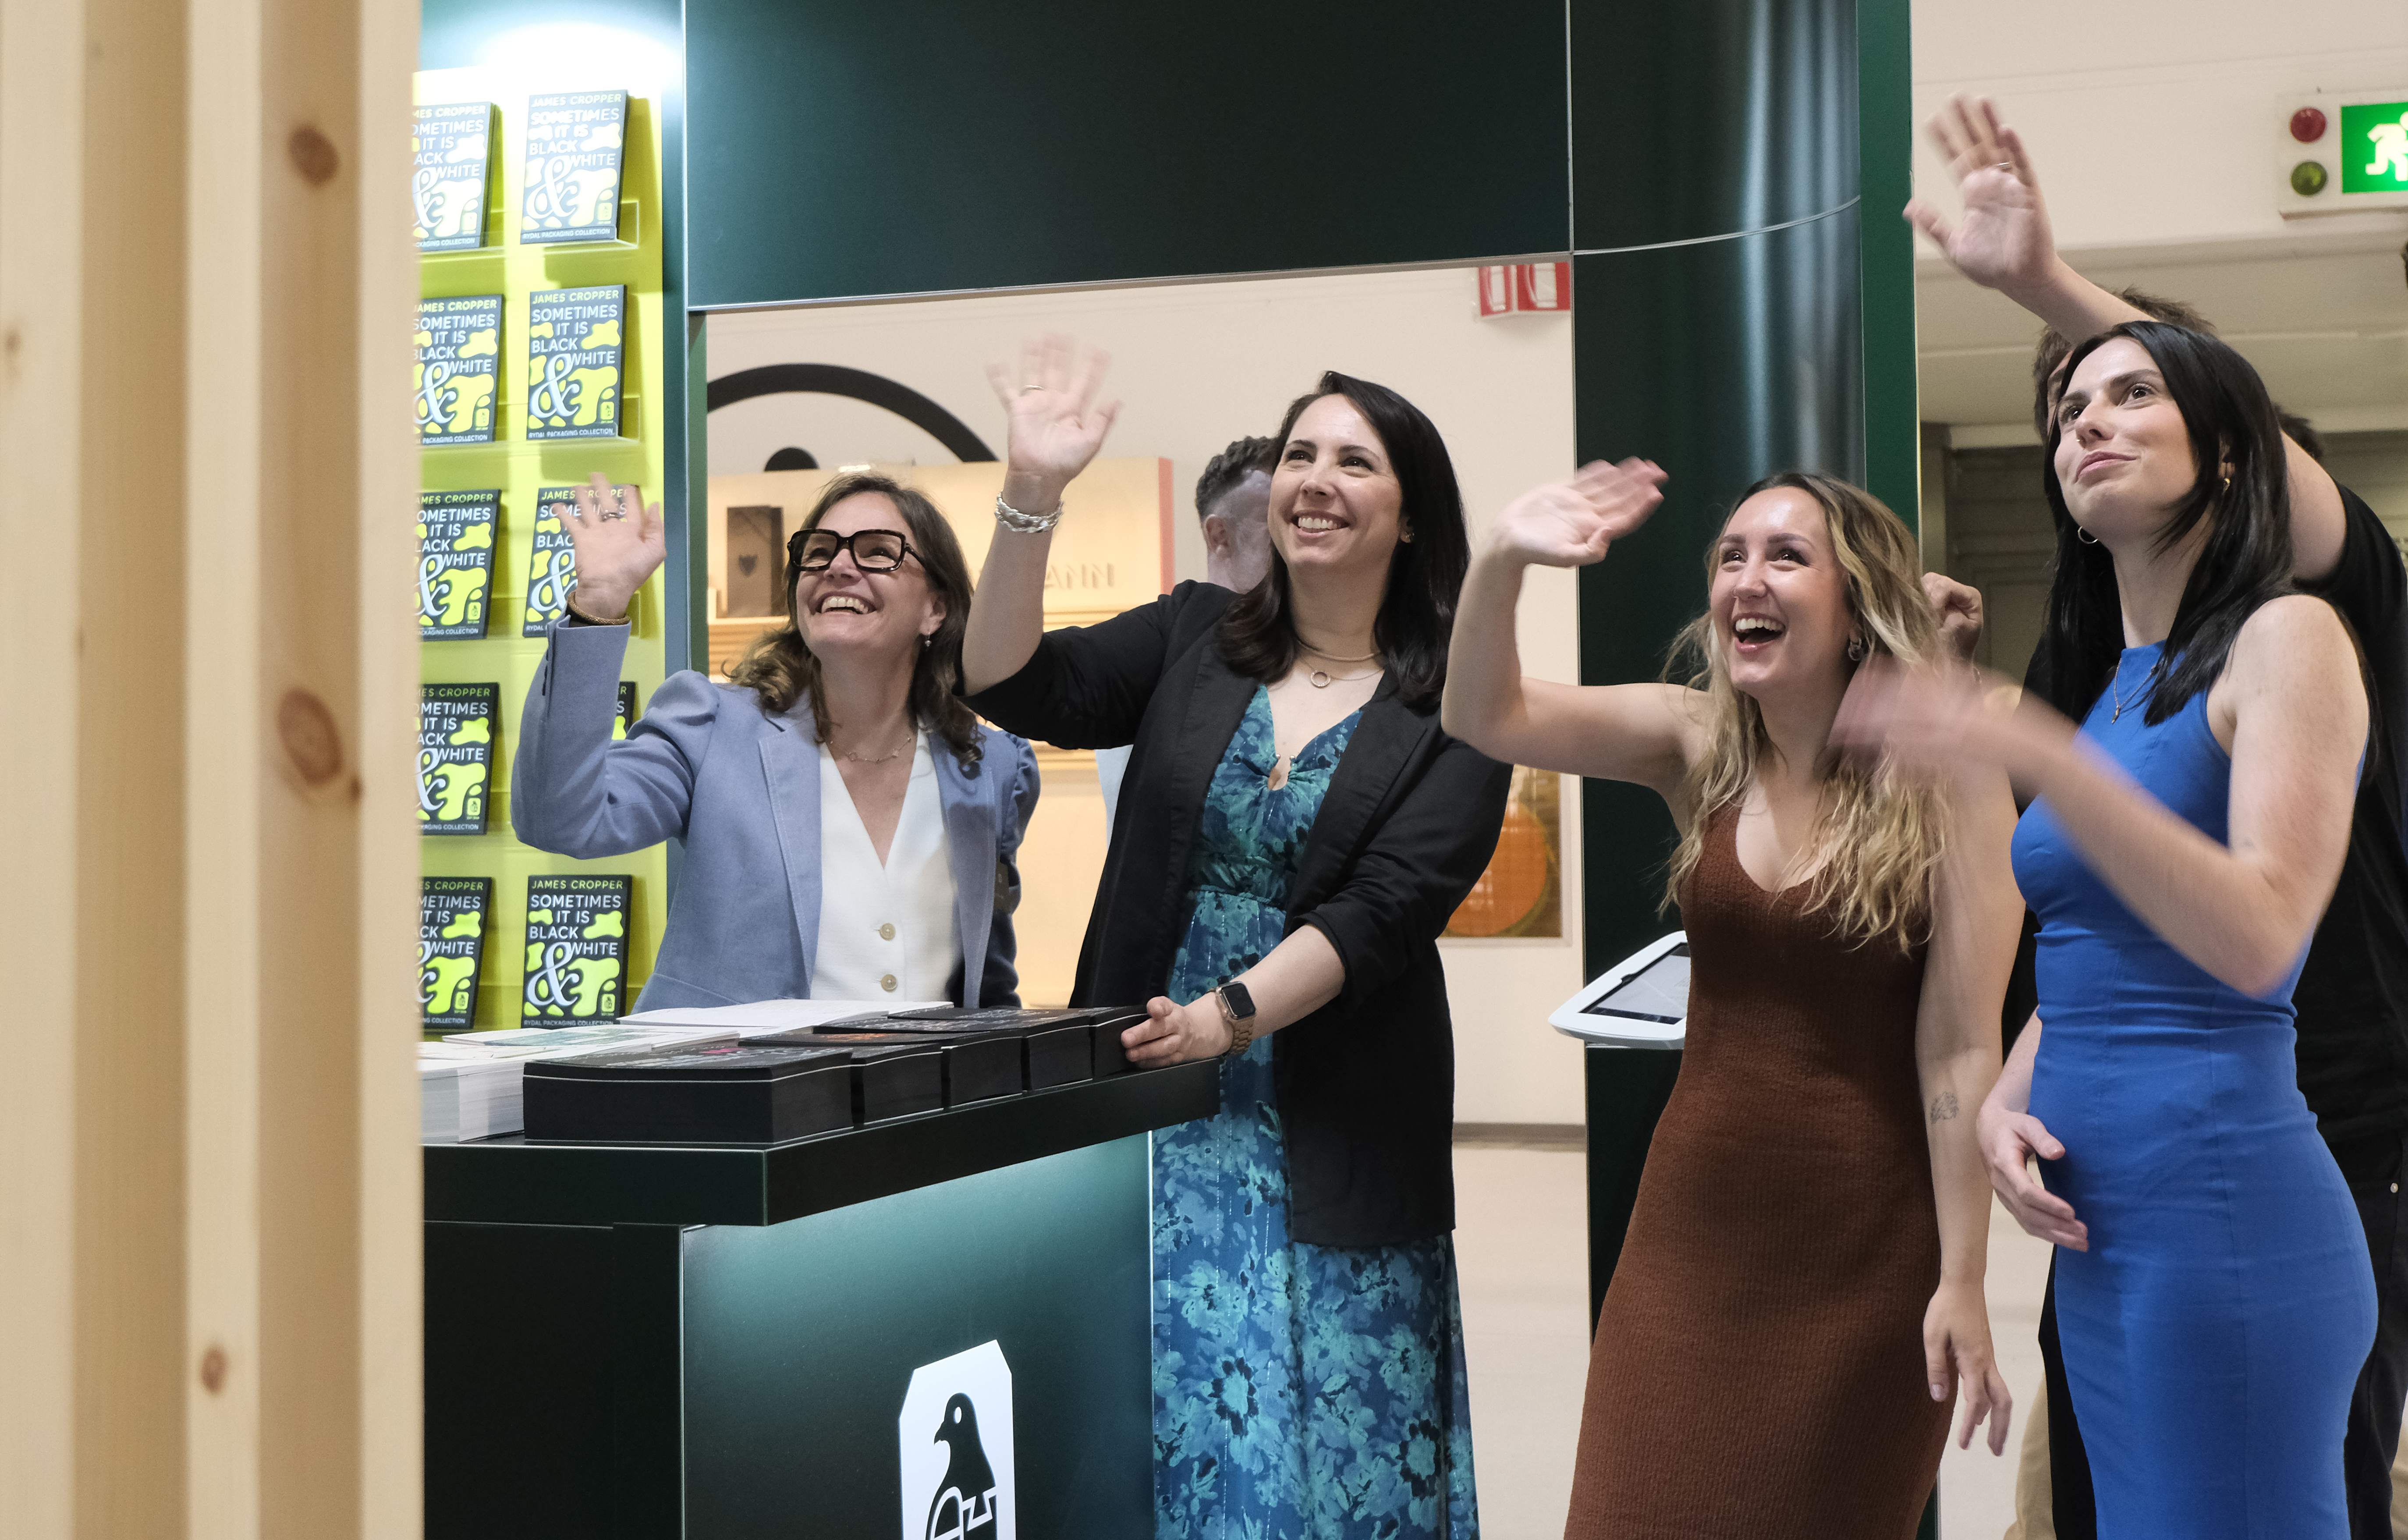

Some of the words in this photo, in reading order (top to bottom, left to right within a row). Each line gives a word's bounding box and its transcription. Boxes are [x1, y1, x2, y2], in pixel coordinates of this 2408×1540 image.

[531, 96, 566, 107] JAMES
[570, 93, 621, 105] CROPPER
[413, 108, 433, 118] MES
[436, 105, 486, 117] CROPPER
[530, 108, 620, 125] SOMETIMES
[412, 119, 484, 135] METIMES
[554, 124, 571, 138] IT
[573, 123, 589, 138] IS
[422, 137, 436, 150] IT
[441, 135, 454, 149] IS
[529, 139, 578, 156] BLACK
[414, 151, 444, 165] ACK
[437, 163, 481, 178] WHITE
[526, 155, 578, 219] &
[571, 153, 616, 167] WHITE
[532, 293, 565, 304] JAMES
[569, 290, 619, 302] CROPPER
[447, 299, 497, 312] CROPPER
[532, 304, 617, 322] SOMETIMES
[557, 323, 570, 336] IT
[575, 321, 588, 334] IS
[434, 331, 448, 344] IT
[452, 330, 466, 344] IS
[531, 337, 578, 353] BLACK
[449, 359, 492, 373] WHITE
[530, 353, 580, 419] &
[570, 351, 616, 365] WHITE
[444, 493, 493, 503] CROPPER
[541, 490, 576, 500] JAMES
[417, 507, 491, 523] OMETIMES
[430, 524, 443, 537] IT
[448, 523, 461, 536] IS
[416, 539, 451, 553] ACK
[536, 534, 575, 548] BLAC
[443, 552, 486, 567] WHITE
[439, 688, 490, 697] CROPPER
[421, 702, 488, 715] METIMES
[424, 717, 438, 730] IT
[443, 717, 457, 731] IS
[417, 732, 446, 745] ACK
[438, 748, 485, 761] WHITE
[434, 881, 484, 891] CROPPER
[532, 880, 567, 889] JAMES
[571, 880, 623, 889] CROPPER
[419, 895, 481, 909] METIMES
[531, 894, 622, 908] SOMETIMES
[420, 910, 432, 923] IT
[437, 910, 450, 923] IS
[557, 910, 571, 923] IT
[576, 910, 590, 923] IS
[529, 926, 579, 940] BLACK
[430, 941, 475, 955] WHITE
[527, 941, 580, 1006] &
[570, 942, 618, 955] WHITE
